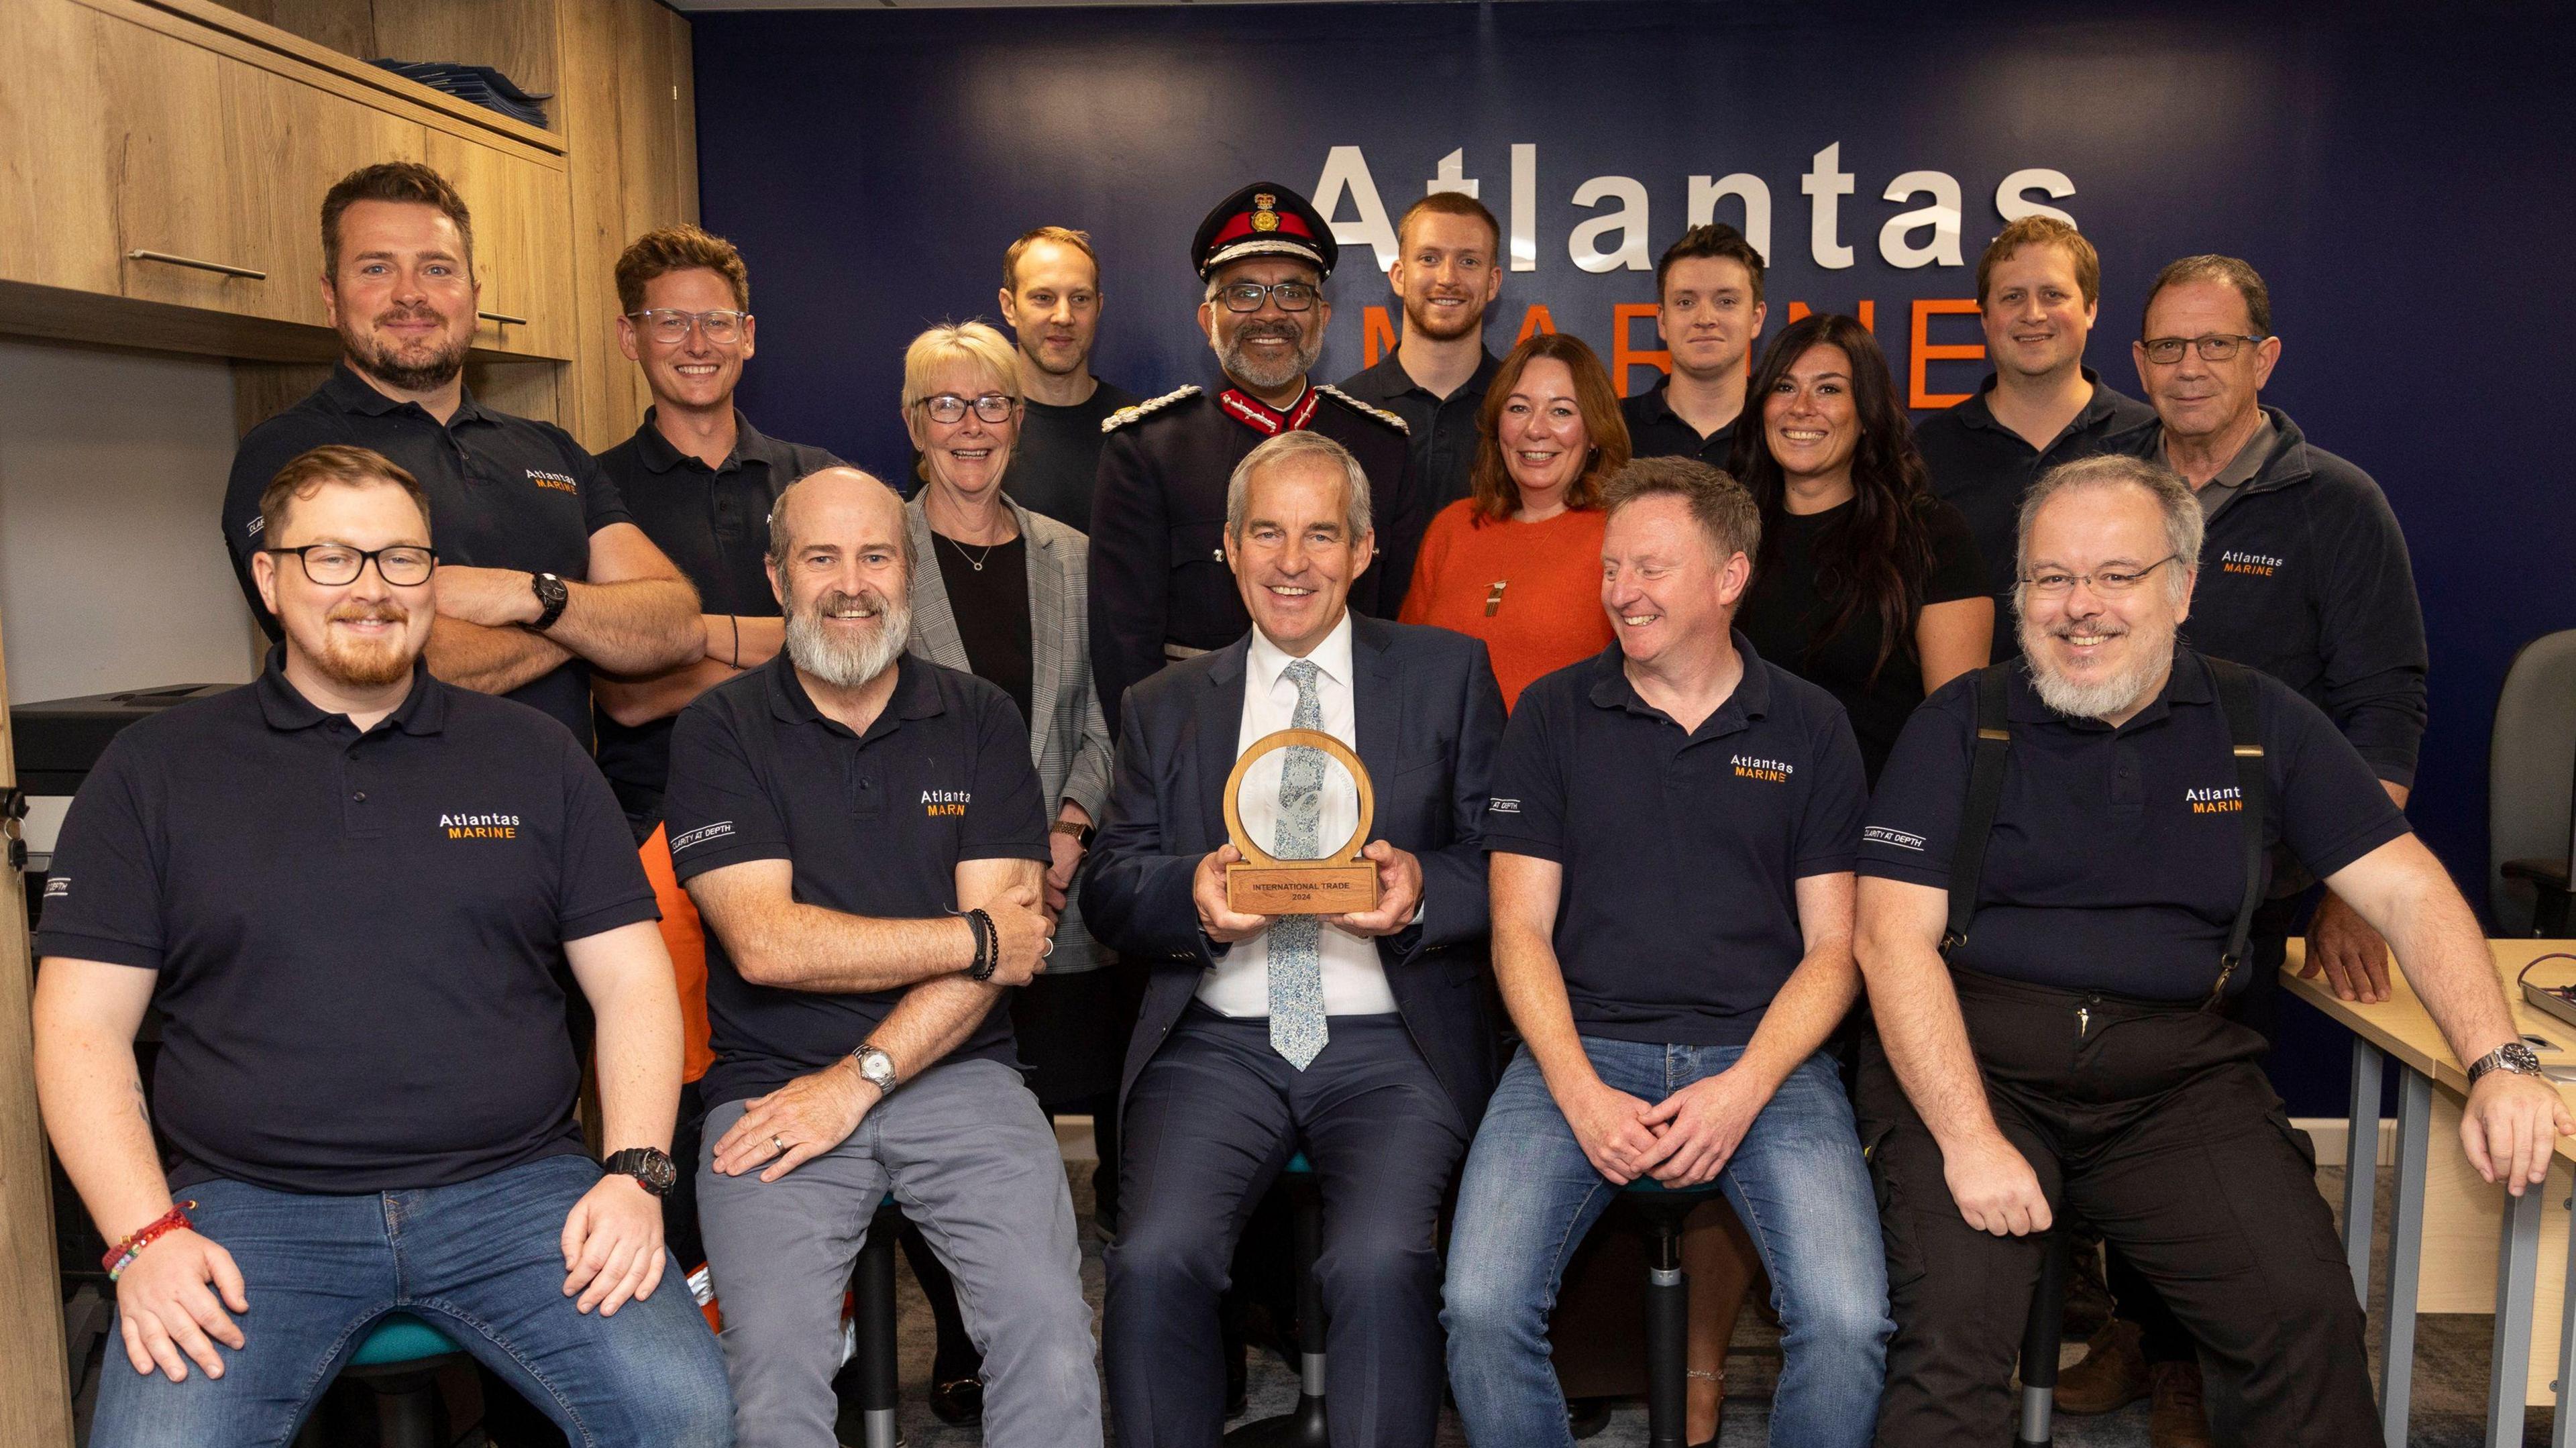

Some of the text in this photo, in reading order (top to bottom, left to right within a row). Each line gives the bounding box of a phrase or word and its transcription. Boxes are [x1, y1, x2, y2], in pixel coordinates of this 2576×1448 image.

[535, 479, 578, 495] MARINE
[2221, 551, 2283, 567] Atlantas
[2223, 563, 2273, 577] MARINE
[1731, 754, 1793, 774] Atlantas
[1735, 766, 1786, 783] MARINE
[920, 789, 971, 803] Atlanta
[2186, 786, 2241, 801] Atlant
[927, 804, 965, 816] MARN
[2192, 799, 2243, 814] MARIN
[439, 812, 520, 827] Atlantas
[448, 826, 516, 839] MARINE
[672, 824, 731, 849] CLARITY AT DEPTH
[1884, 832, 1894, 840] AT
[1894, 834, 1923, 847] DEPTH
[1252, 882, 1350, 891] INTERNATIONAL TRADE
